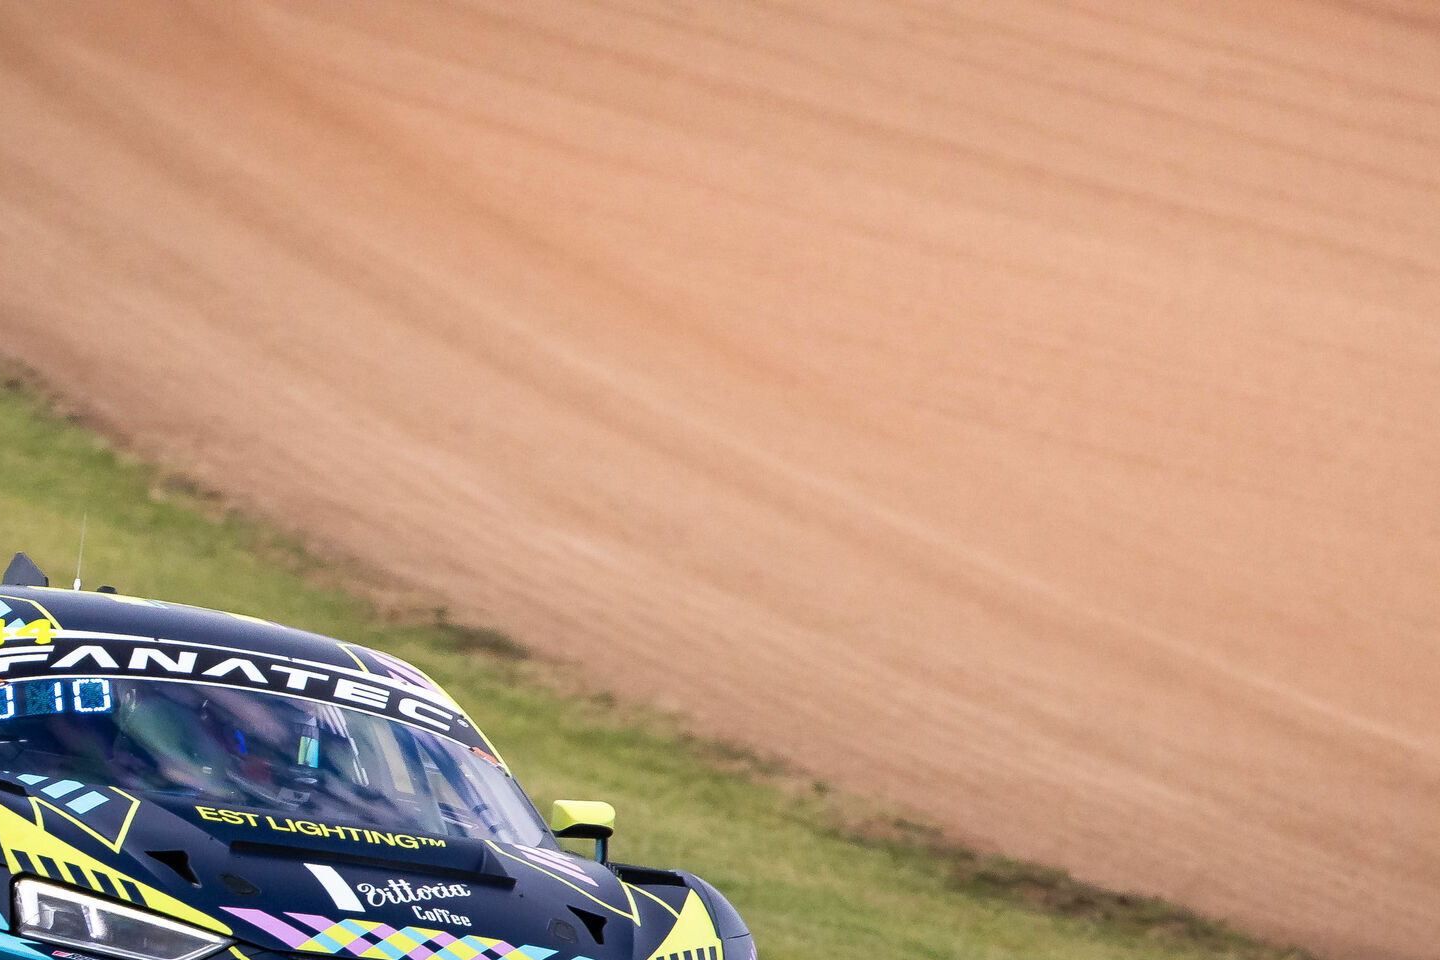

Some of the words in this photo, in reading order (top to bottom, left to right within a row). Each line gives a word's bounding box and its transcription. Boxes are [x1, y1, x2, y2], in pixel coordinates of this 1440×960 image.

[194, 805, 260, 828] EST
[356, 878, 472, 908] Vittoria
[411, 904, 473, 928] Coffee
